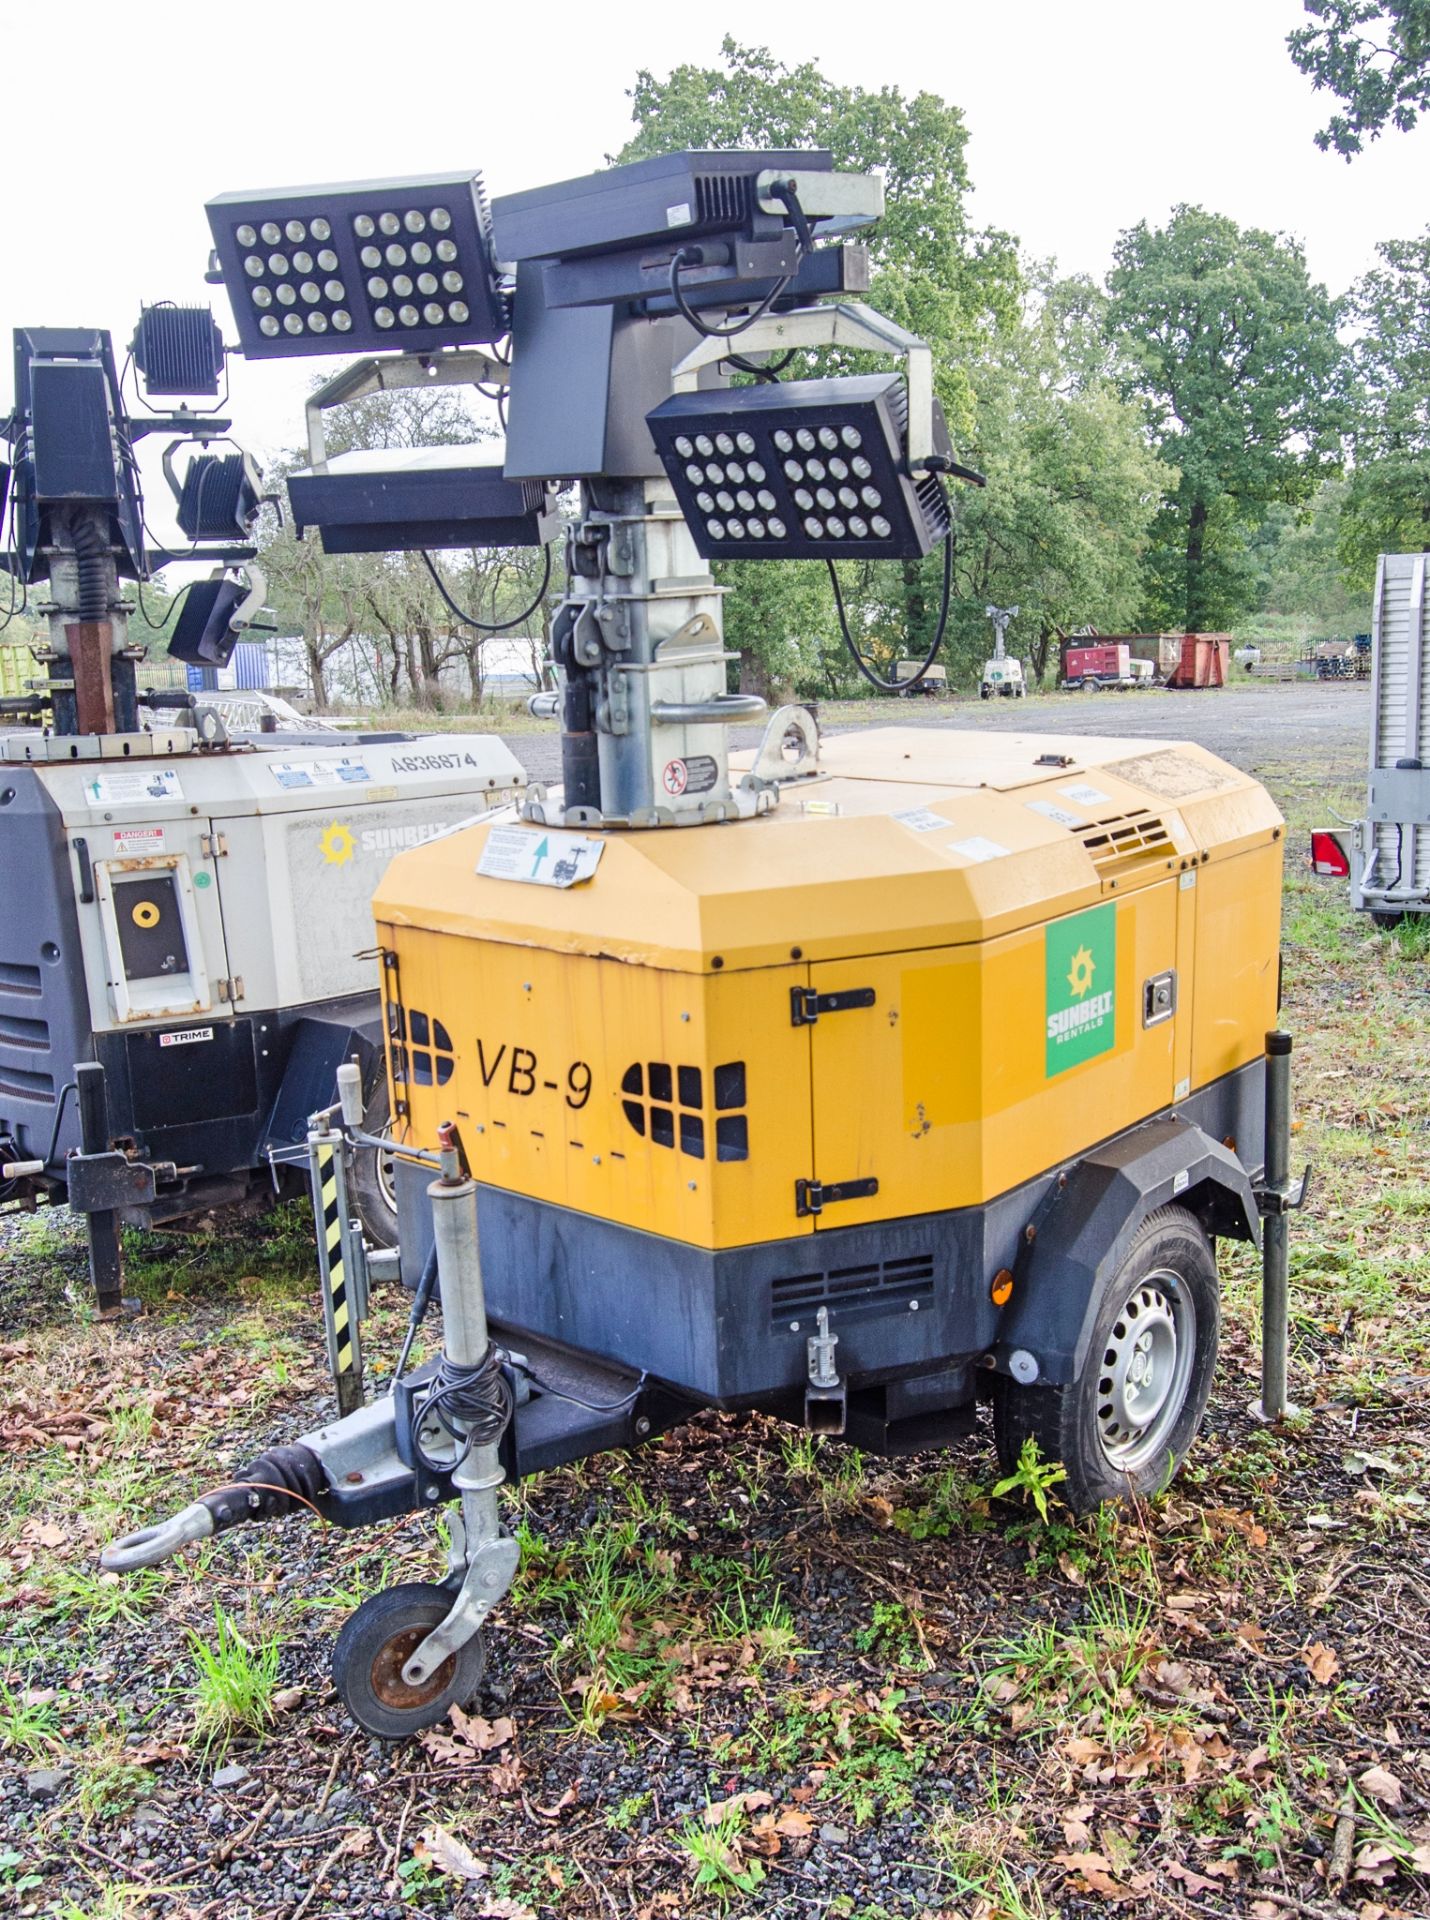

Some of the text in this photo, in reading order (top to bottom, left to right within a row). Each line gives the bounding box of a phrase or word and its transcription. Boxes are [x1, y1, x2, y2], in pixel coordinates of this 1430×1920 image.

[391, 753, 477, 773] A836874
[1047, 990, 1112, 1039] SUNBELT
[172, 1030, 210, 1042] TRIME
[1056, 1017, 1104, 1045] RENTALS
[476, 1038, 592, 1110] VB-9
